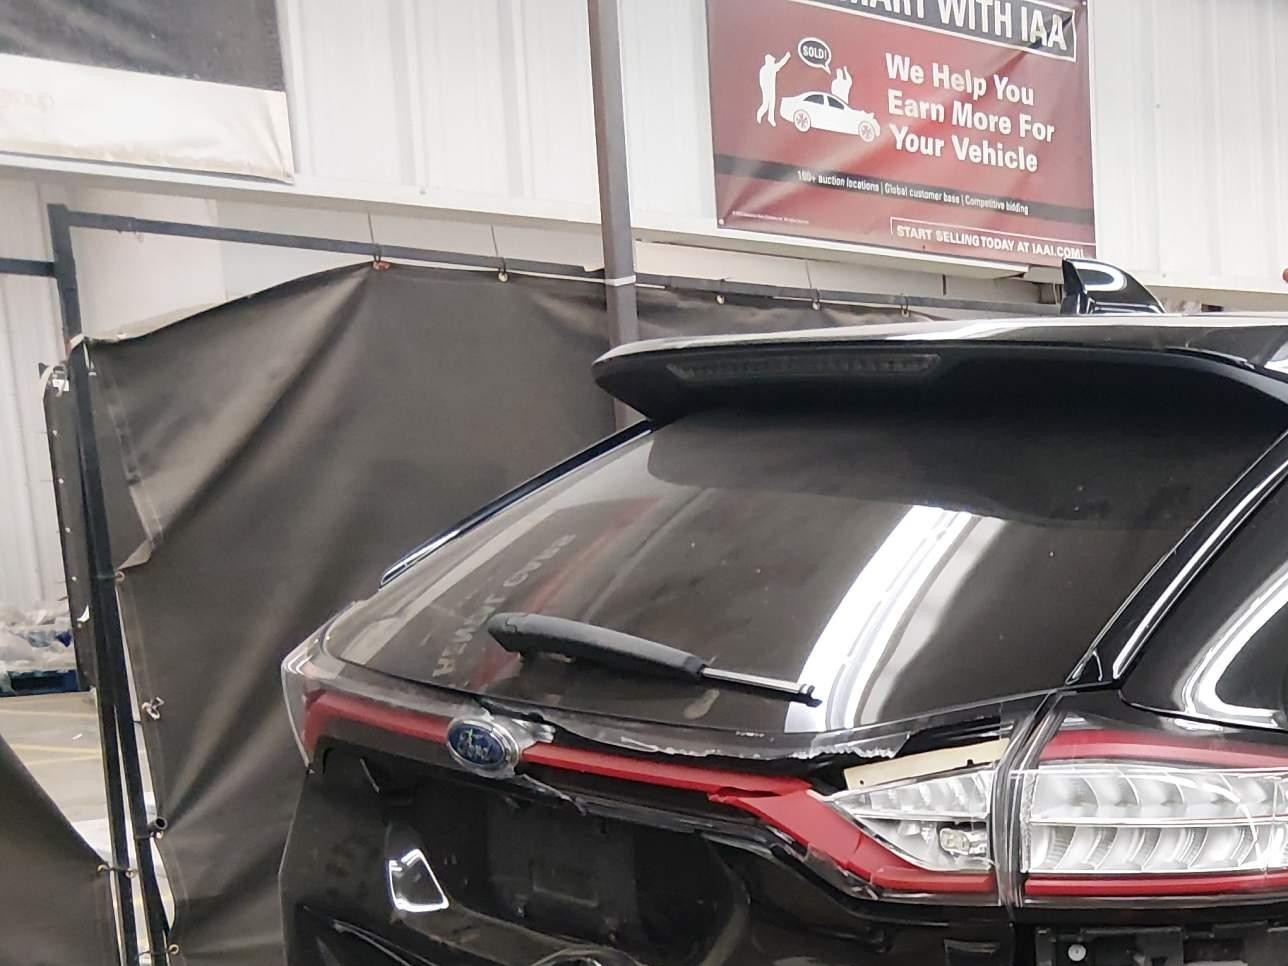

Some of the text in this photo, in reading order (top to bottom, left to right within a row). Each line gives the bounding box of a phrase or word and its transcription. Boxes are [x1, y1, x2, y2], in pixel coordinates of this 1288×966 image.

[938, 0, 1013, 38] WITH
[1021, 6, 1067, 50] IAA
[802, 45, 827, 60] SOLD!
[885, 53, 1035, 106] We Help You
[887, 88, 1055, 142] Earn More For
[889, 123, 1038, 172] Your Vehicle
[818, 174, 845, 188] auction
[846, 177, 880, 192] locations
[884, 182, 908, 197] Global
[909, 188, 942, 201] customer
[943, 191, 960, 204] base
[965, 194, 1005, 210] Competitive
[1006, 201, 1029, 215] bidding
[897, 224, 932, 240] START
[936, 230, 980, 247] SELLING
[980, 237, 1015, 253] TODAY
[1017, 242, 1030, 253] AT
